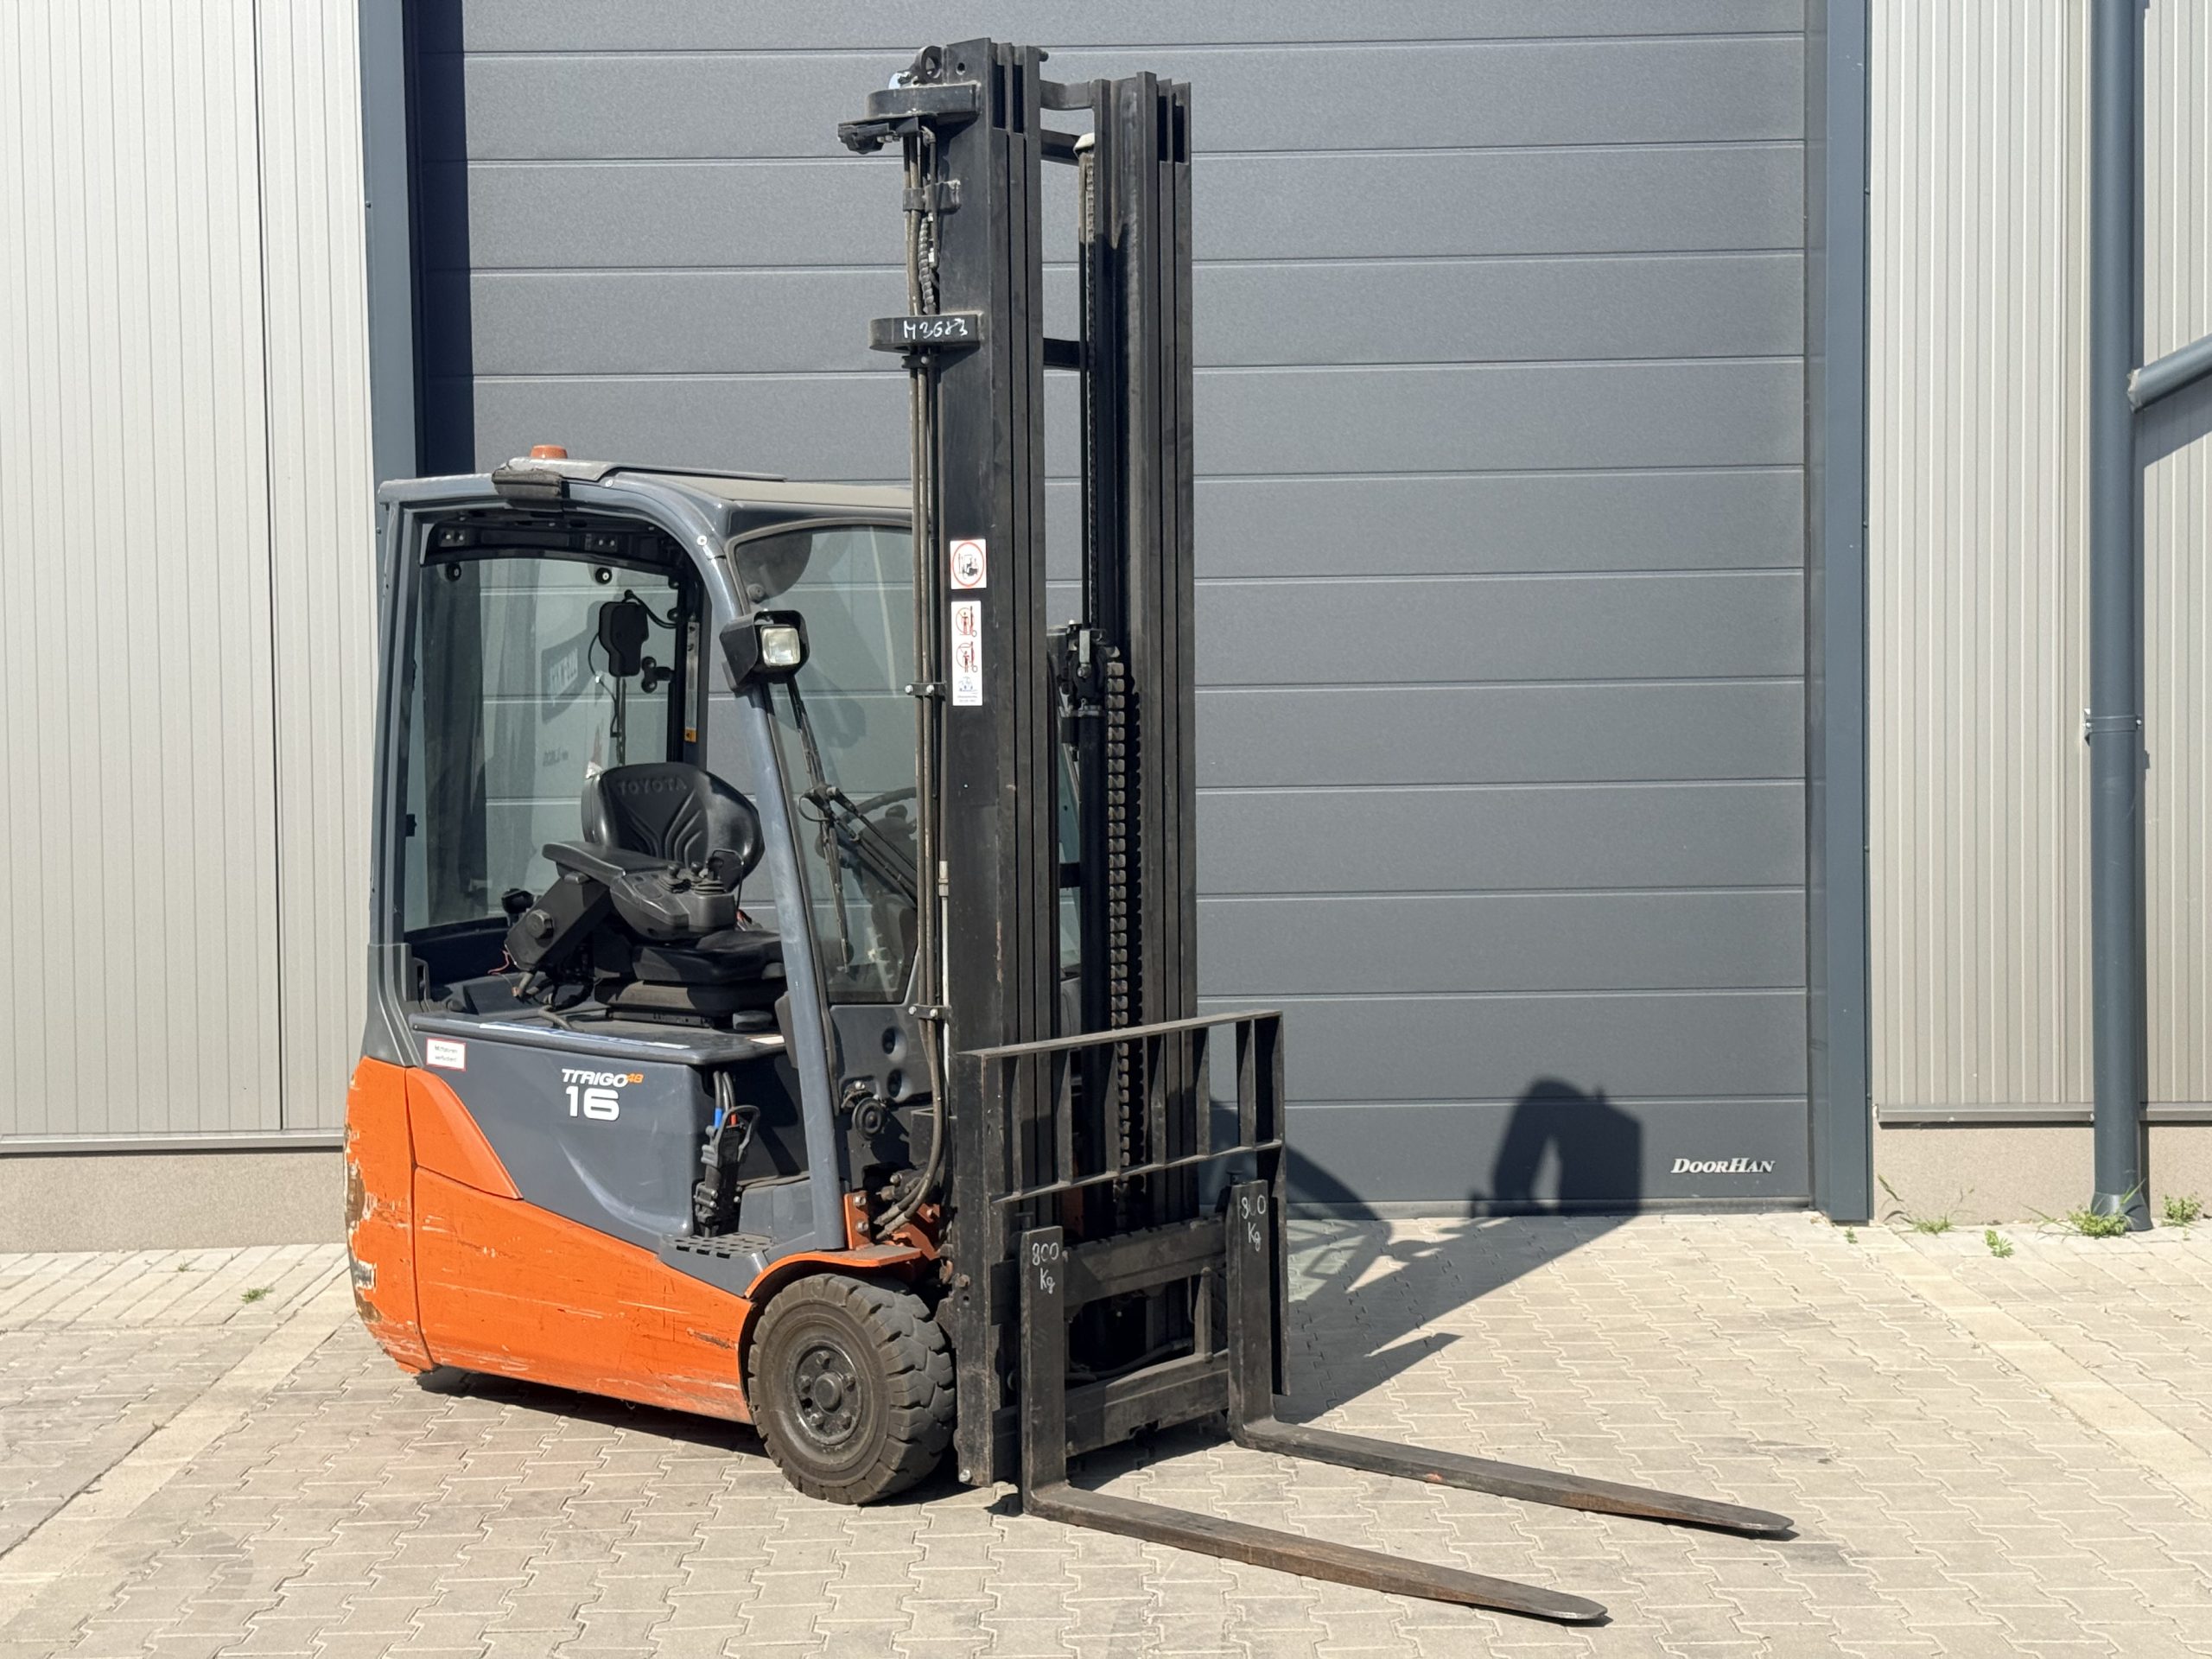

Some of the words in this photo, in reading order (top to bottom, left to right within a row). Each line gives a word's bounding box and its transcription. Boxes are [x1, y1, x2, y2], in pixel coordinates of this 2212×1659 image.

[618, 778, 688, 796] TOYOTA
[565, 1085, 620, 1122] 16
[1032, 1242, 1059, 1266] 800
